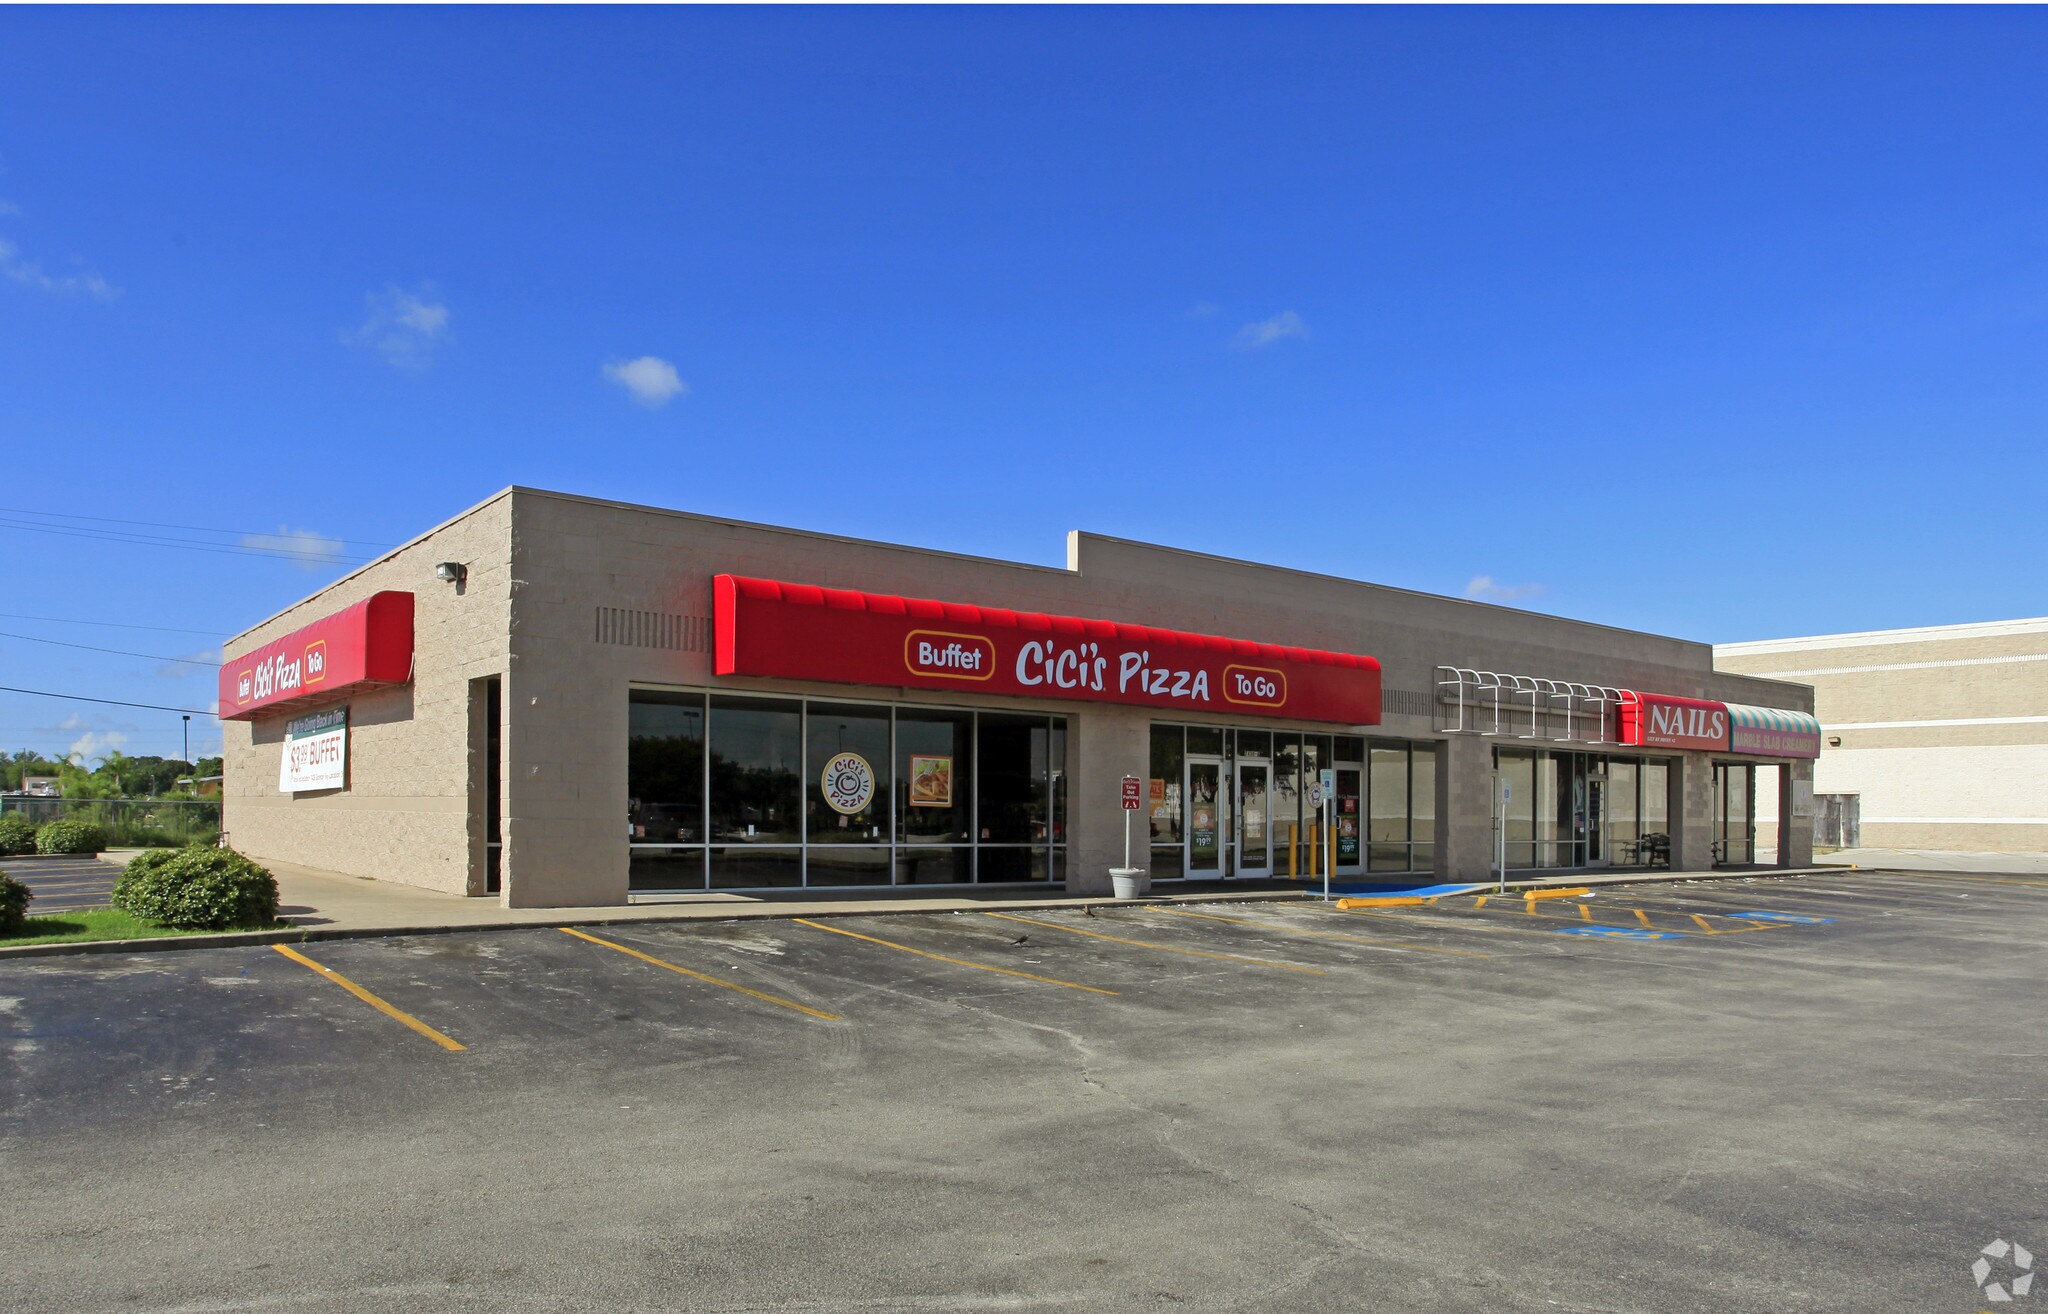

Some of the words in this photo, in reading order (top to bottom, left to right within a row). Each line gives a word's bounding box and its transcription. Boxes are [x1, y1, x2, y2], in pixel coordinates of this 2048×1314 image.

[314, 651, 323, 672] Go
[919, 642, 982, 670] Buffet
[1016, 639, 1107, 692] CiCi's
[1235, 674, 1252, 695] To
[1254, 676, 1276, 698] Go
[1648, 704, 1724, 739] NAILS
[310, 736, 341, 765] BUFFET
[1734, 731, 1761, 748] MARBLE
[1763, 735, 1780, 750] SLAB
[1782, 737, 1816, 752] CREAMERY
[834, 759, 866, 776] CiCi's
